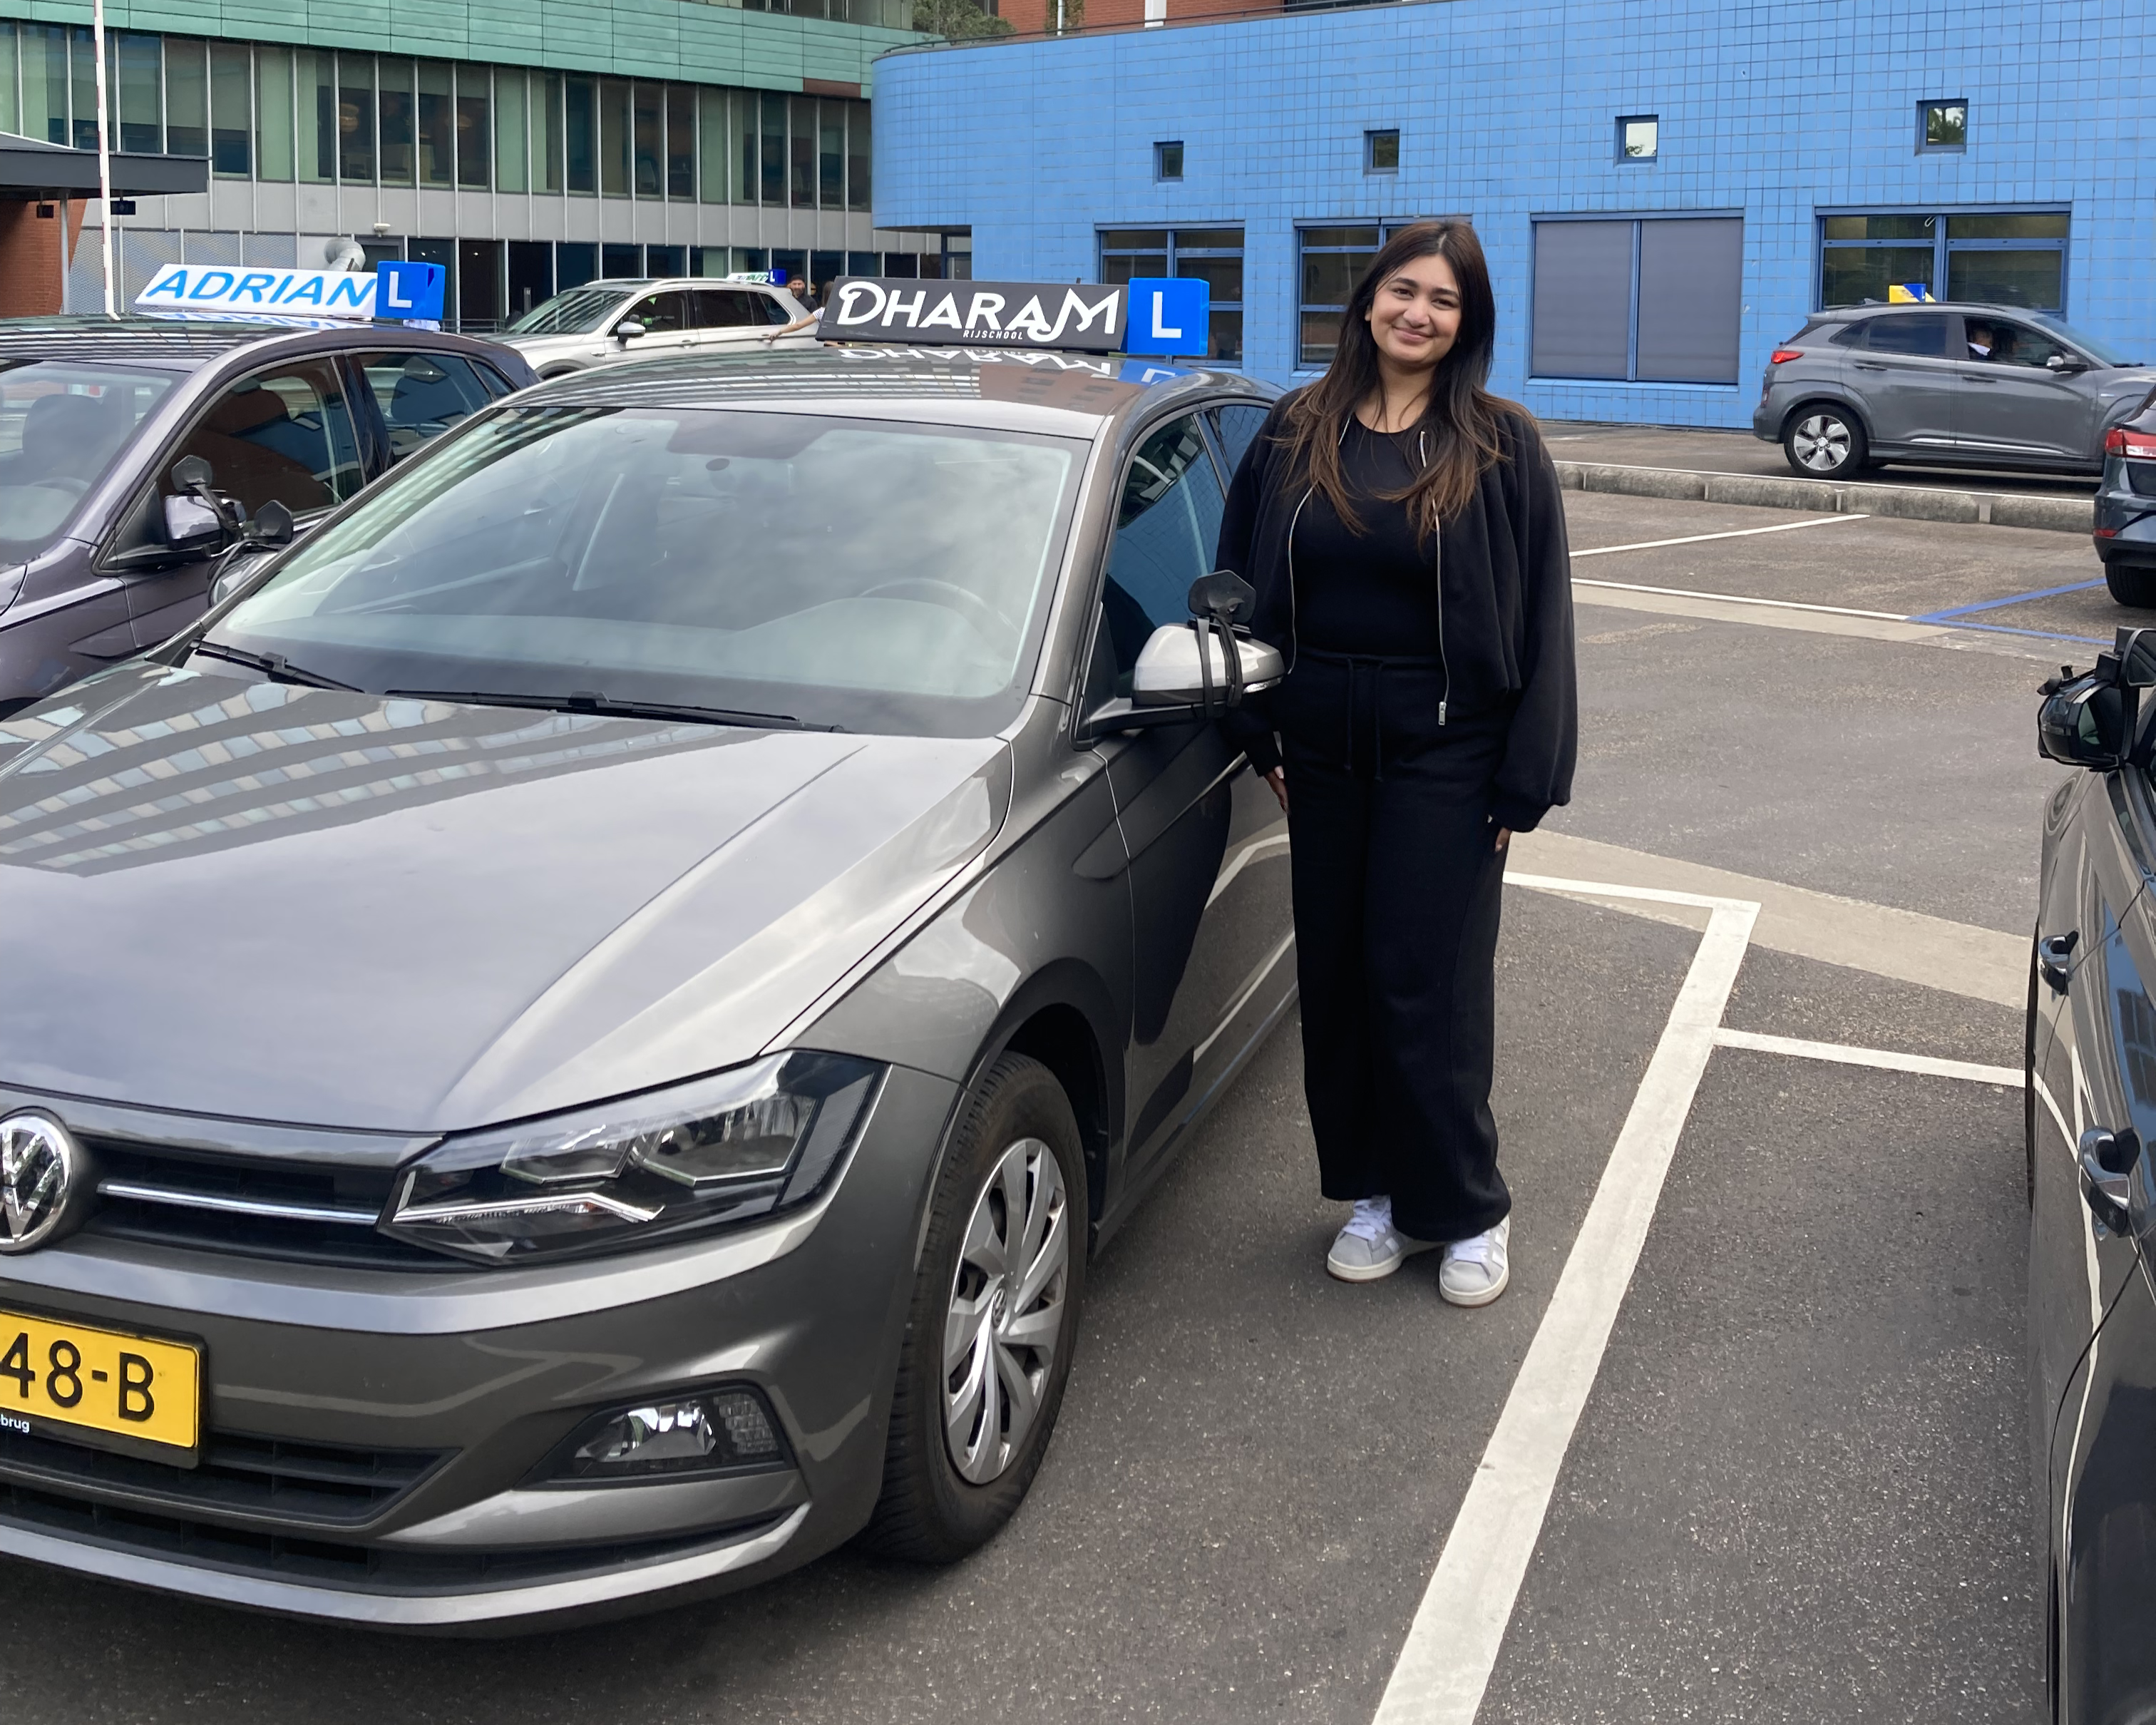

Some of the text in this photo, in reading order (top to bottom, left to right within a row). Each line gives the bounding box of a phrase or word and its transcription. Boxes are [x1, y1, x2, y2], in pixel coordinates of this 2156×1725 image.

[146, 270, 376, 307] ADRIAN
[388, 271, 412, 308] L
[770, 271, 776, 282] L
[838, 281, 1119, 342] DHARAM
[1152, 291, 1182, 339] L
[962, 329, 1025, 341] RIJSCHOOL
[0, 1332, 155, 1422] 48-B
[0, 1413, 30, 1433] brug
